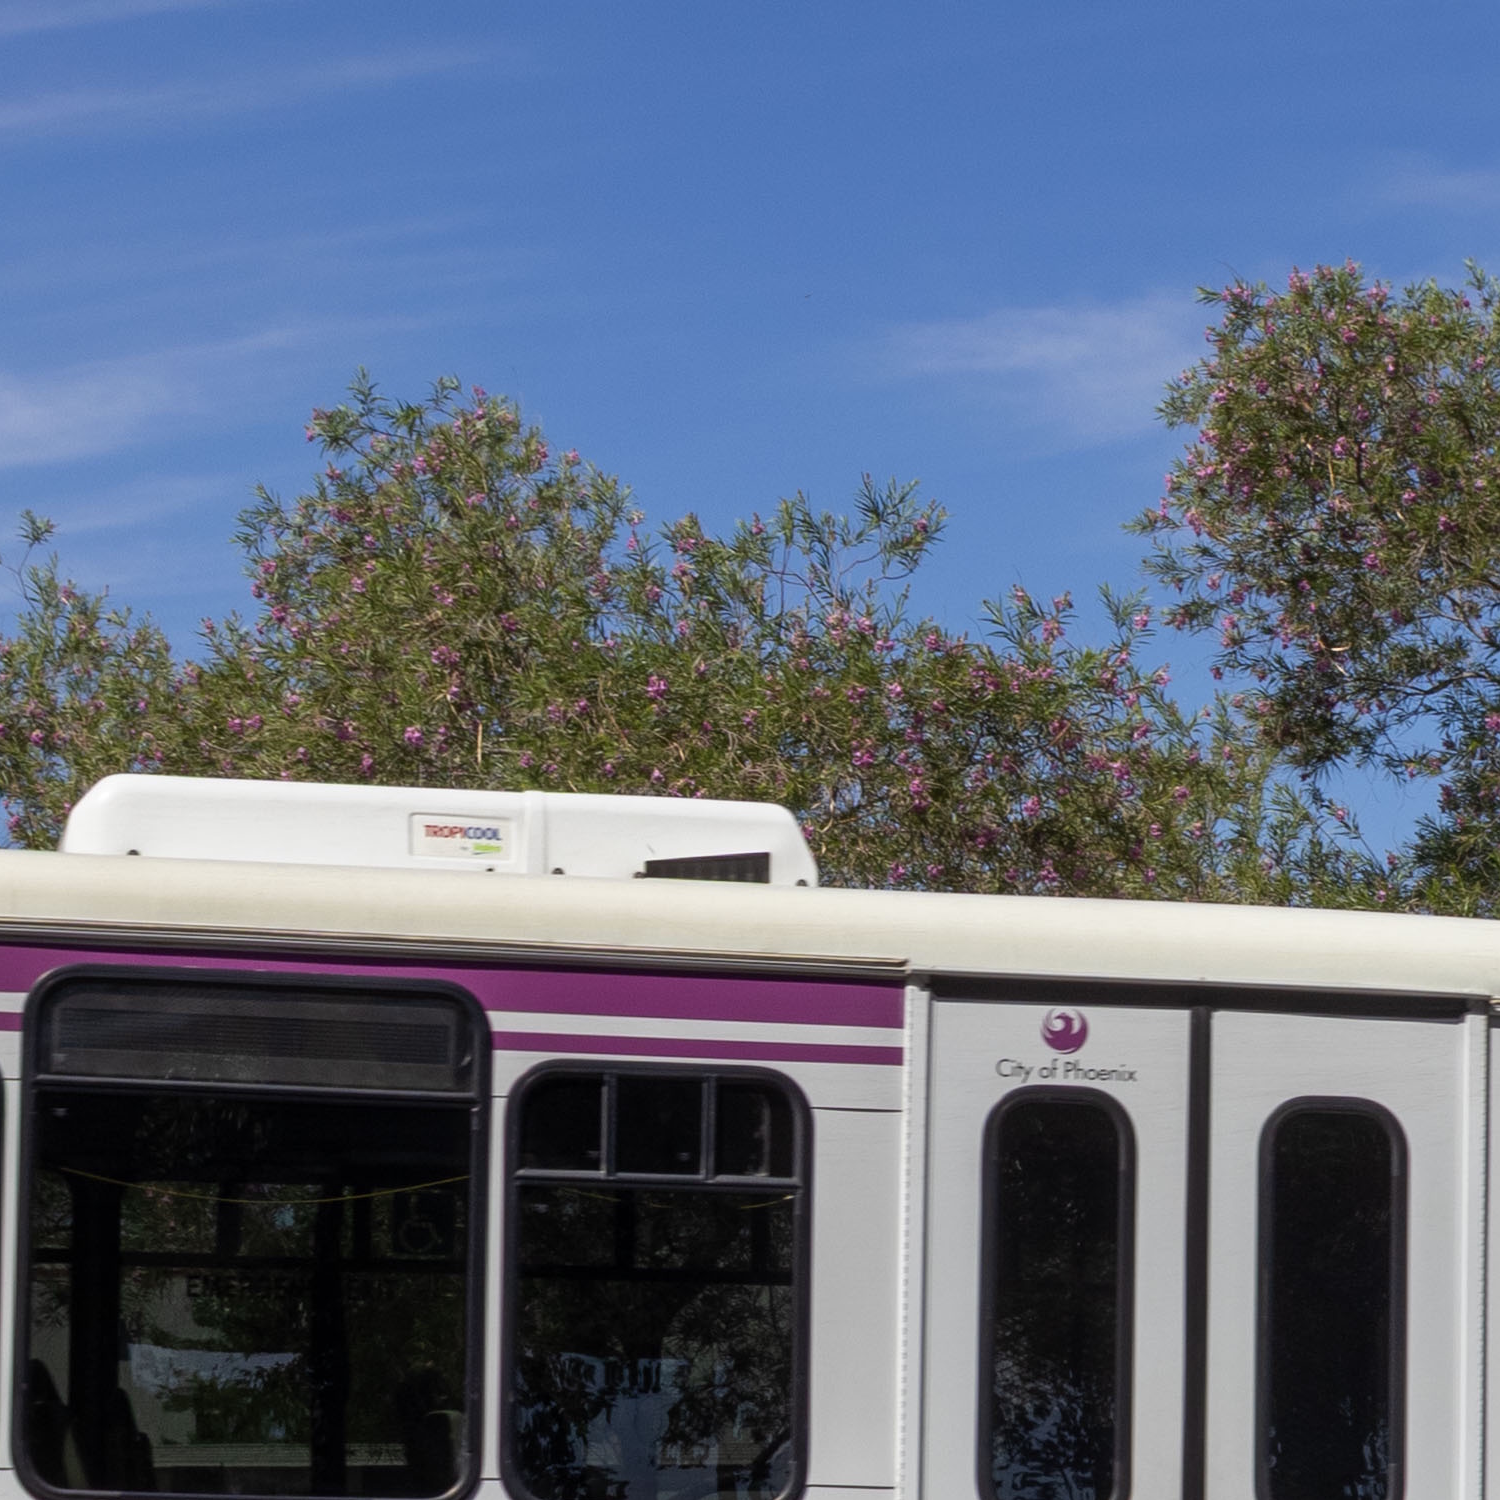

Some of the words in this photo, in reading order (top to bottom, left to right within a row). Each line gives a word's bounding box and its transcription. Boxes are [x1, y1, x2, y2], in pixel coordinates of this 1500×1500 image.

[424, 824, 503, 841] TROPICOOL
[995, 1059, 1034, 1084] City
[1039, 1059, 1058, 1080] of
[1063, 1060, 1137, 1082] Phoenix
